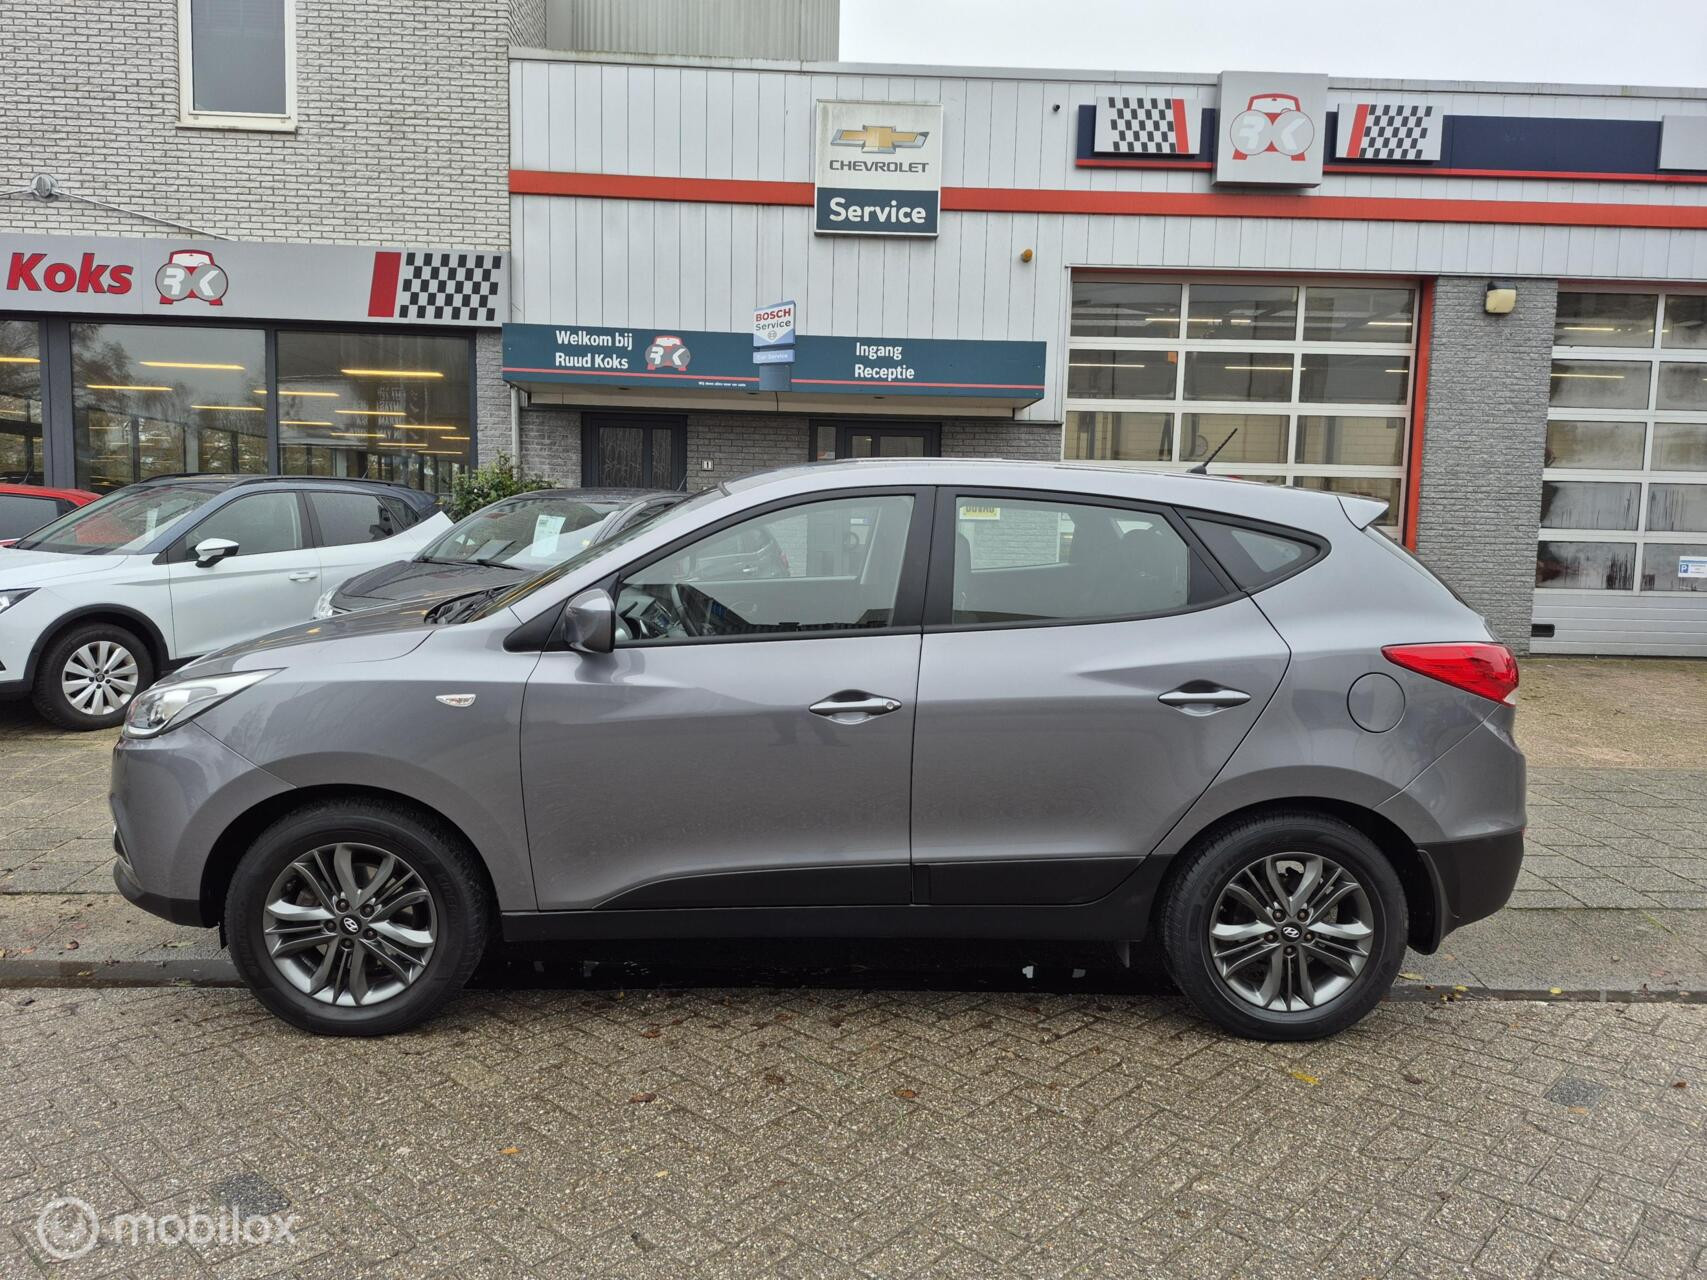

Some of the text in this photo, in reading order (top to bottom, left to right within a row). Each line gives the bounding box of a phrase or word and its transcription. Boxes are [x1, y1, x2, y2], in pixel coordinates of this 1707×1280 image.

[829, 159, 930, 174] CHEVROLET
[829, 197, 927, 224] Service
[6, 252, 134, 295] Koks
[755, 307, 792, 323] BOSCH
[755, 319, 792, 332] Service
[555, 330, 633, 351] Welkom bij
[855, 341, 903, 361] Ingang
[555, 352, 629, 370] Ruud Koks
[854, 363, 915, 382] Receptie
